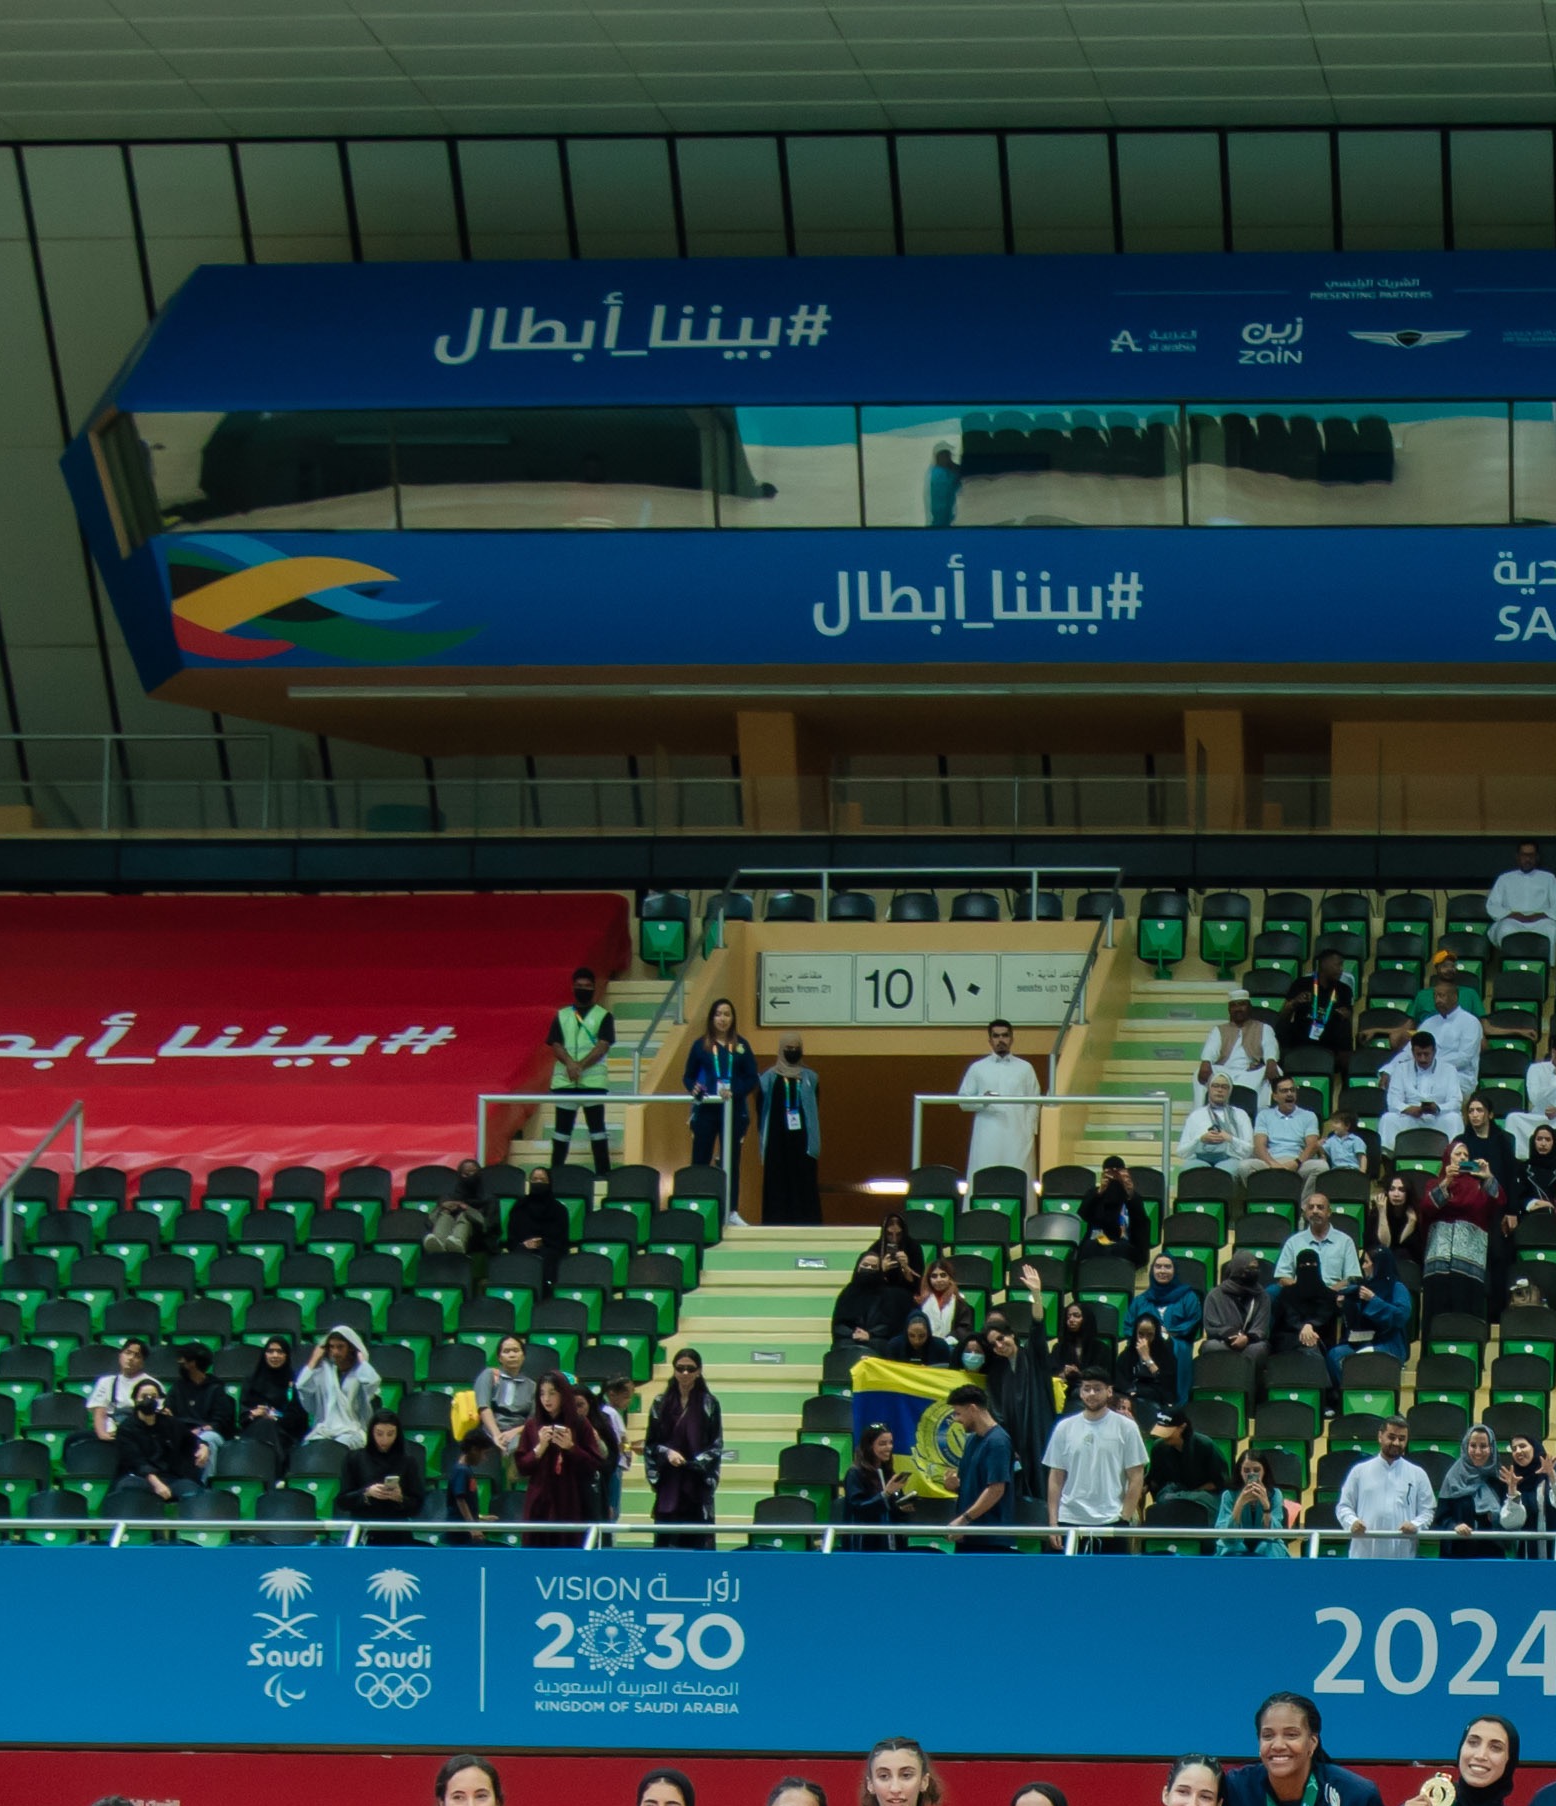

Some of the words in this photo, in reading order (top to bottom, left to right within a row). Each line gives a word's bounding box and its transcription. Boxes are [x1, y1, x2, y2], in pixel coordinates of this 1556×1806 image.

[1310, 290, 1376, 300] PRESENTING
[1379, 290, 1433, 299] PARTNERS
[1241, 316, 1304, 345] زين
[814, 554, 1143, 635] #بيننا_أبطال
[768, 984, 794, 994] seats
[797, 984, 816, 994] from
[819, 984, 831, 994] 21
[865, 969, 913, 1008] 10
[1016, 983, 1044, 993] seats
[1045, 984, 1058, 996] up
[1060, 983, 1071, 993] to
[536, 1577, 640, 1600] VISION
[248, 1643, 322, 1667] Saudi
[356, 1644, 430, 1668] Saudi
[534, 1679, 613, 1697] السعودية
[617, 1680, 667, 1697] العربية
[671, 1681, 739, 1697] المملكة
[535, 1700, 605, 1712] KINGDOM
[609, 1701, 629, 1712] OF
[634, 1701, 678, 1713] SAUDI
[682, 1702, 739, 1714] ARABIA
